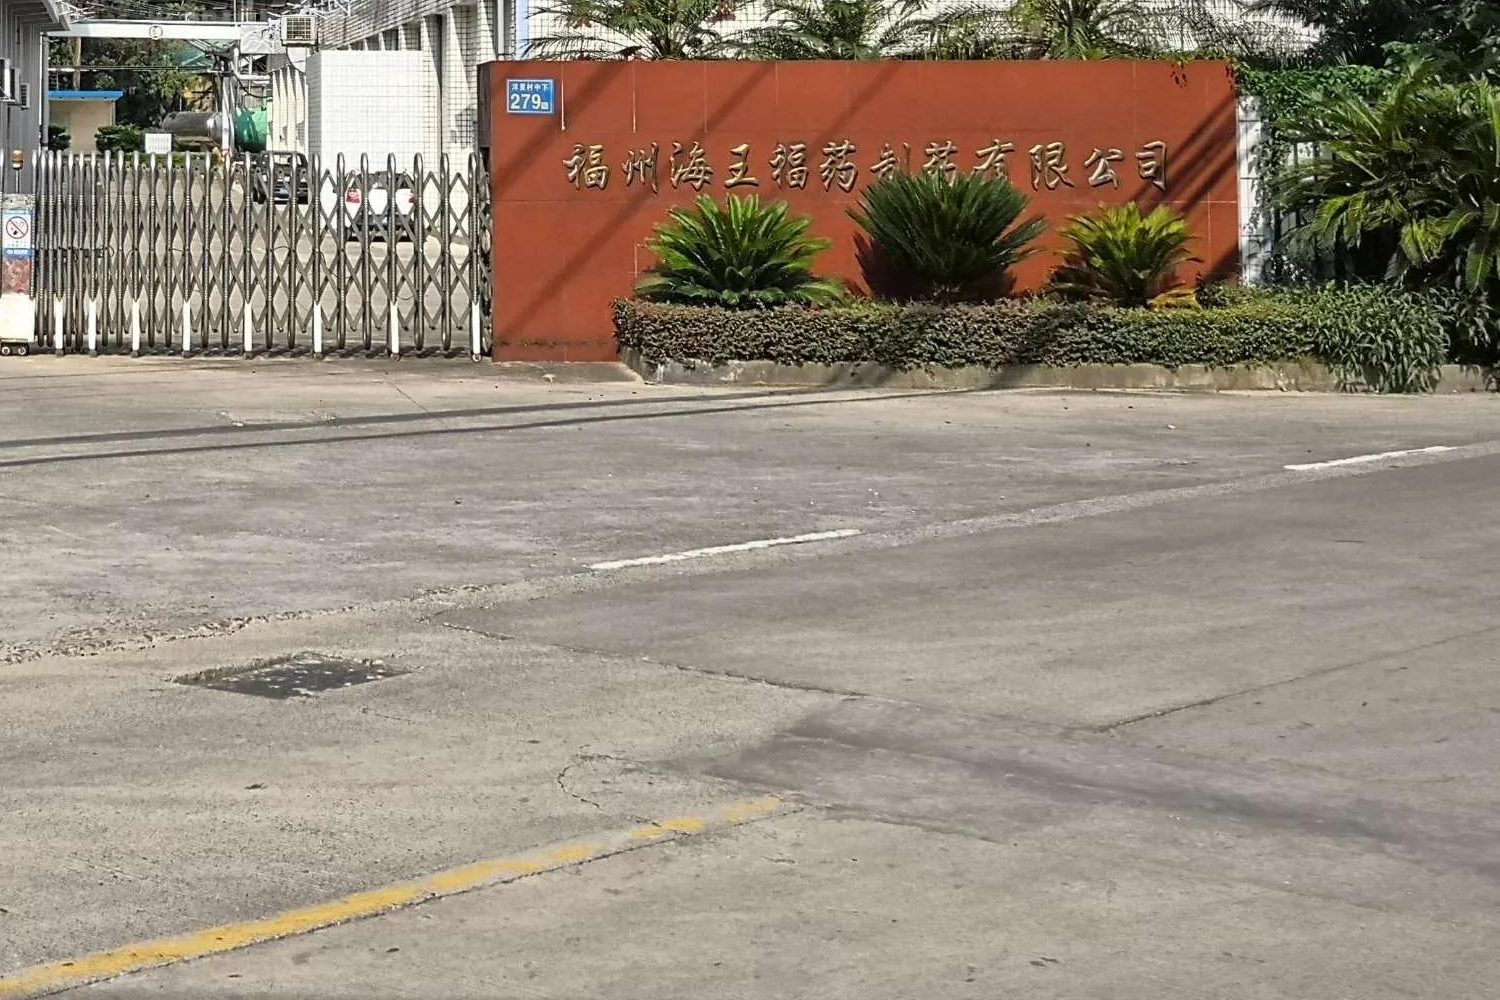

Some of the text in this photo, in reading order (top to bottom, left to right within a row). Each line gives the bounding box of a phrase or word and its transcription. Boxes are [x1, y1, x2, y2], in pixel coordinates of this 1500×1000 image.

[562, 139, 1169, 193] 福州海王福药制药有限公司
